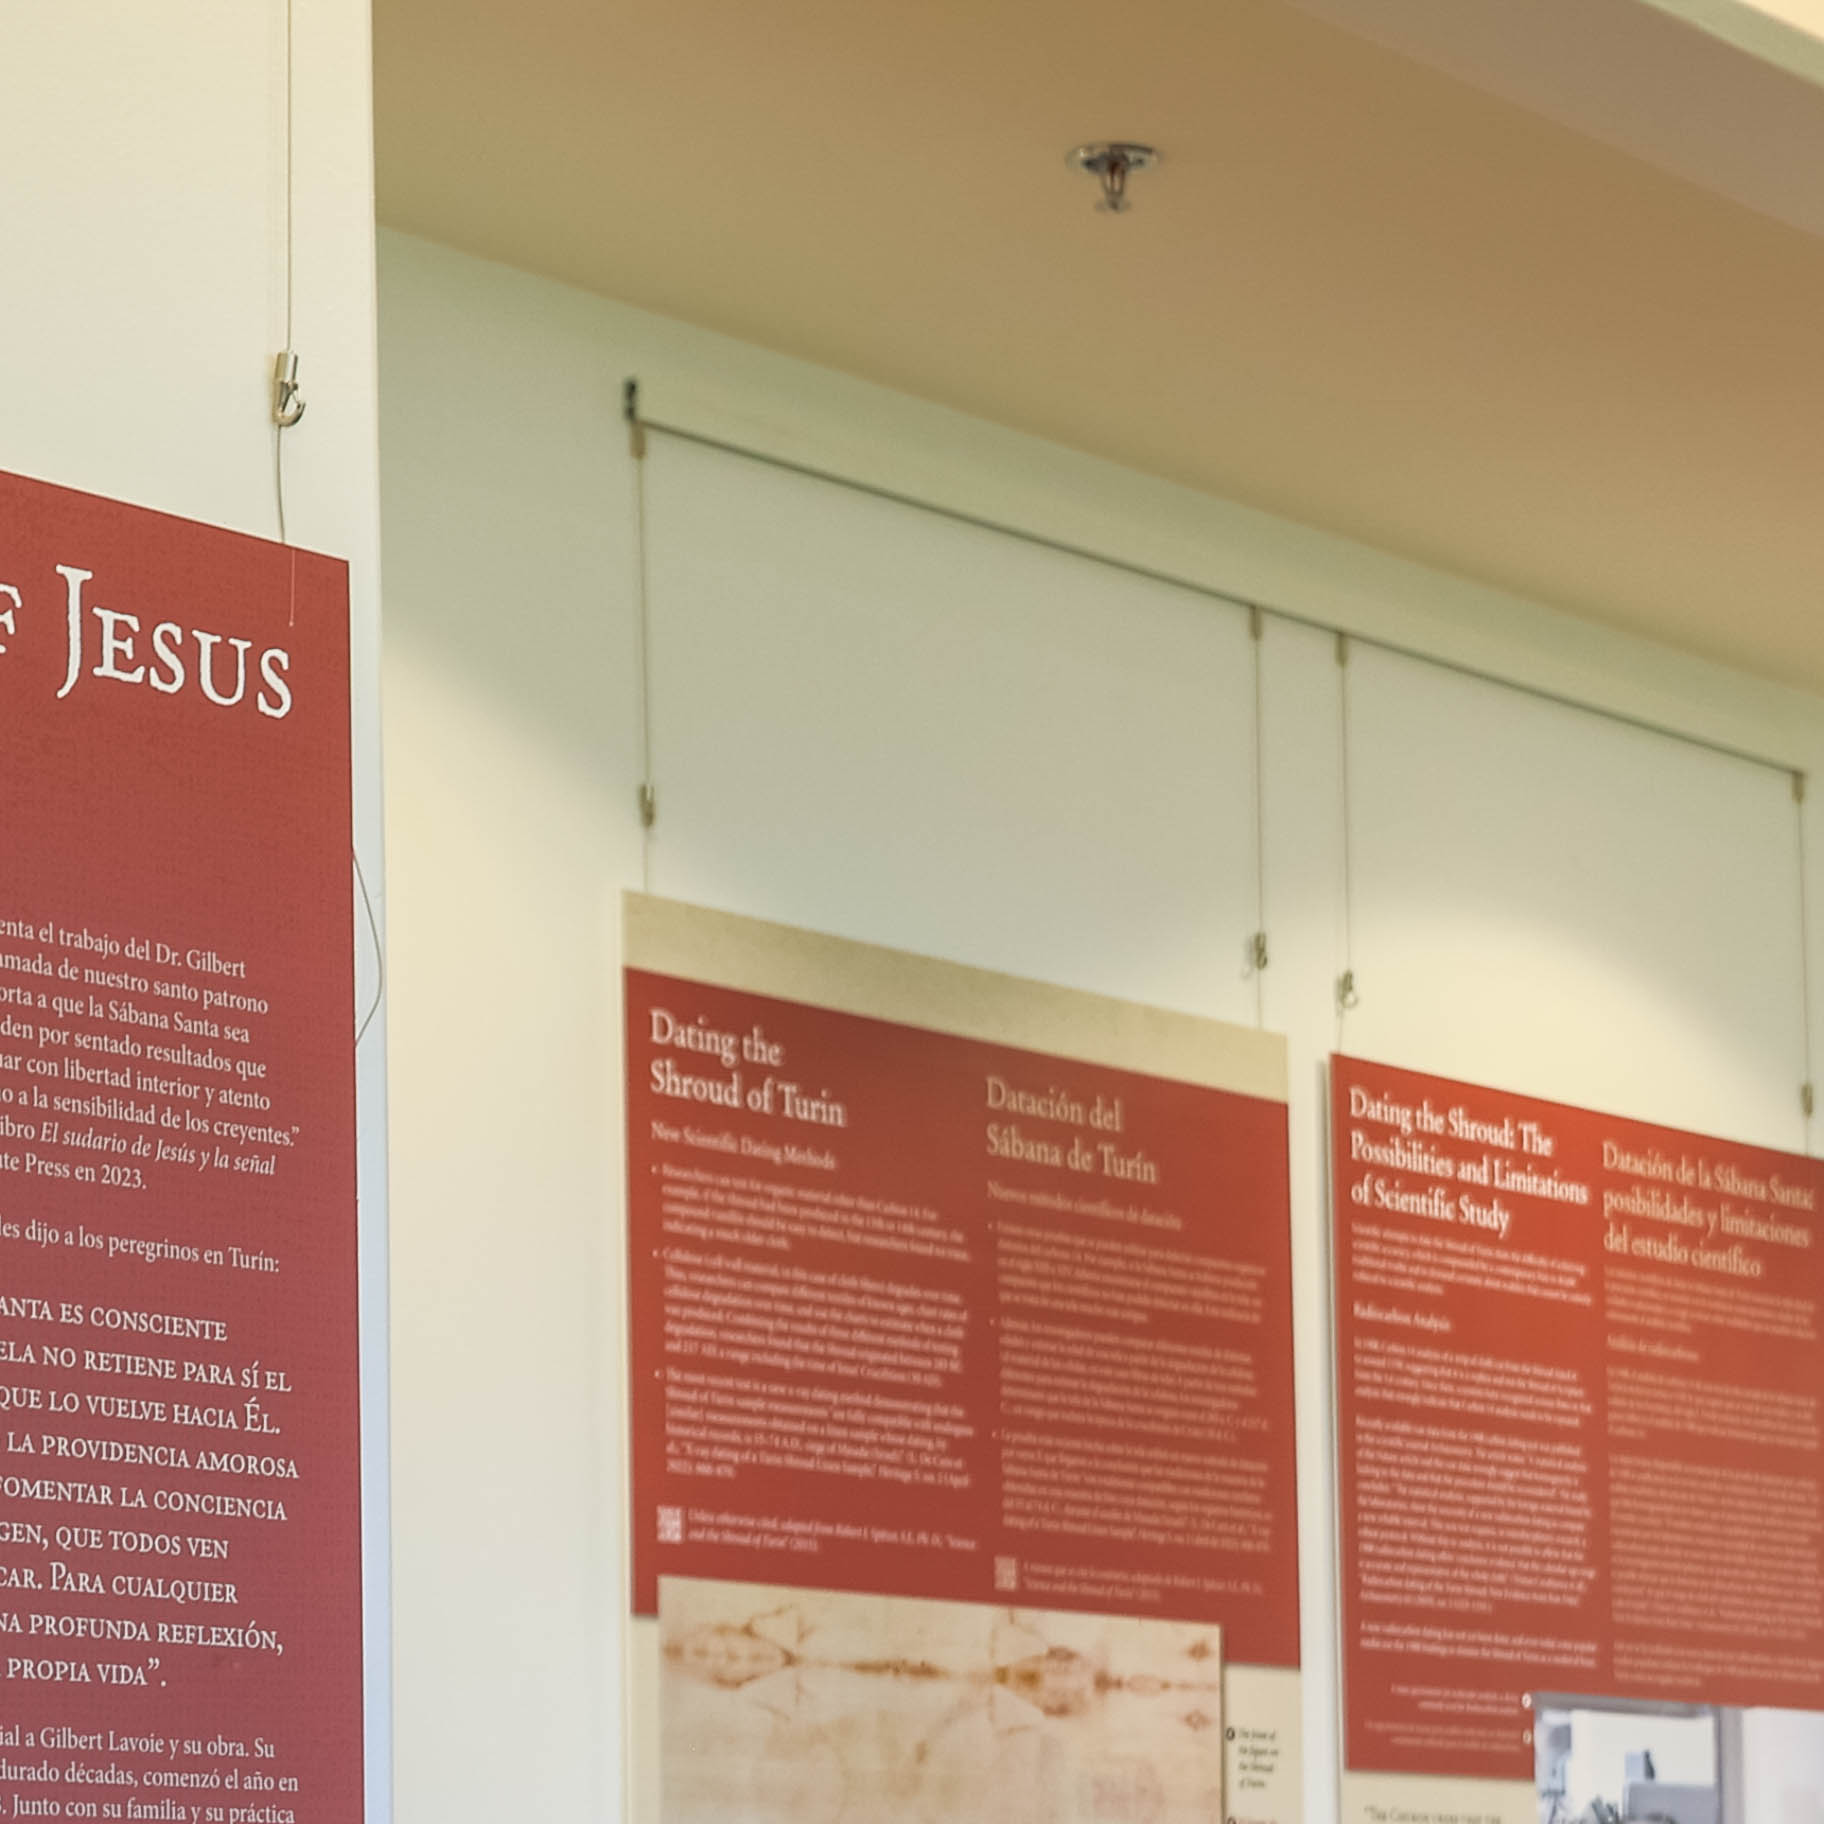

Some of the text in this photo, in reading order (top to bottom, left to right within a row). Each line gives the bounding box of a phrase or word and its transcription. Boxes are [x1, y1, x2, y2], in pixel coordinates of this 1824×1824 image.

[55, 563, 294, 720] JESUS
[651, 1008, 781, 1067] Dating the
[651, 1059, 845, 1127] Shroud of Turin
[987, 1076, 1122, 1132] Datación del
[1350, 1087, 1553, 1157] Dating the Shroud: The
[987, 1124, 1157, 1184] Sábana de Turín
[1351, 1130, 1589, 1204] Possibilities and Limitations
[1603, 1140, 1673, 1181] Datación
[1675, 1156, 1696, 1186] de
[1698, 1159, 1713, 1190] la
[1713, 1164, 1767, 1201] Sábana
[1351, 1173, 1510, 1238] of Scientific Study
[1603, 1186, 1810, 1247] posibilidades y limitaciones
[1603, 1222, 1762, 1277] del estudio científico
[58, 1302, 85, 1326] ES
[89, 1305, 229, 1342] CONSCIENTE
